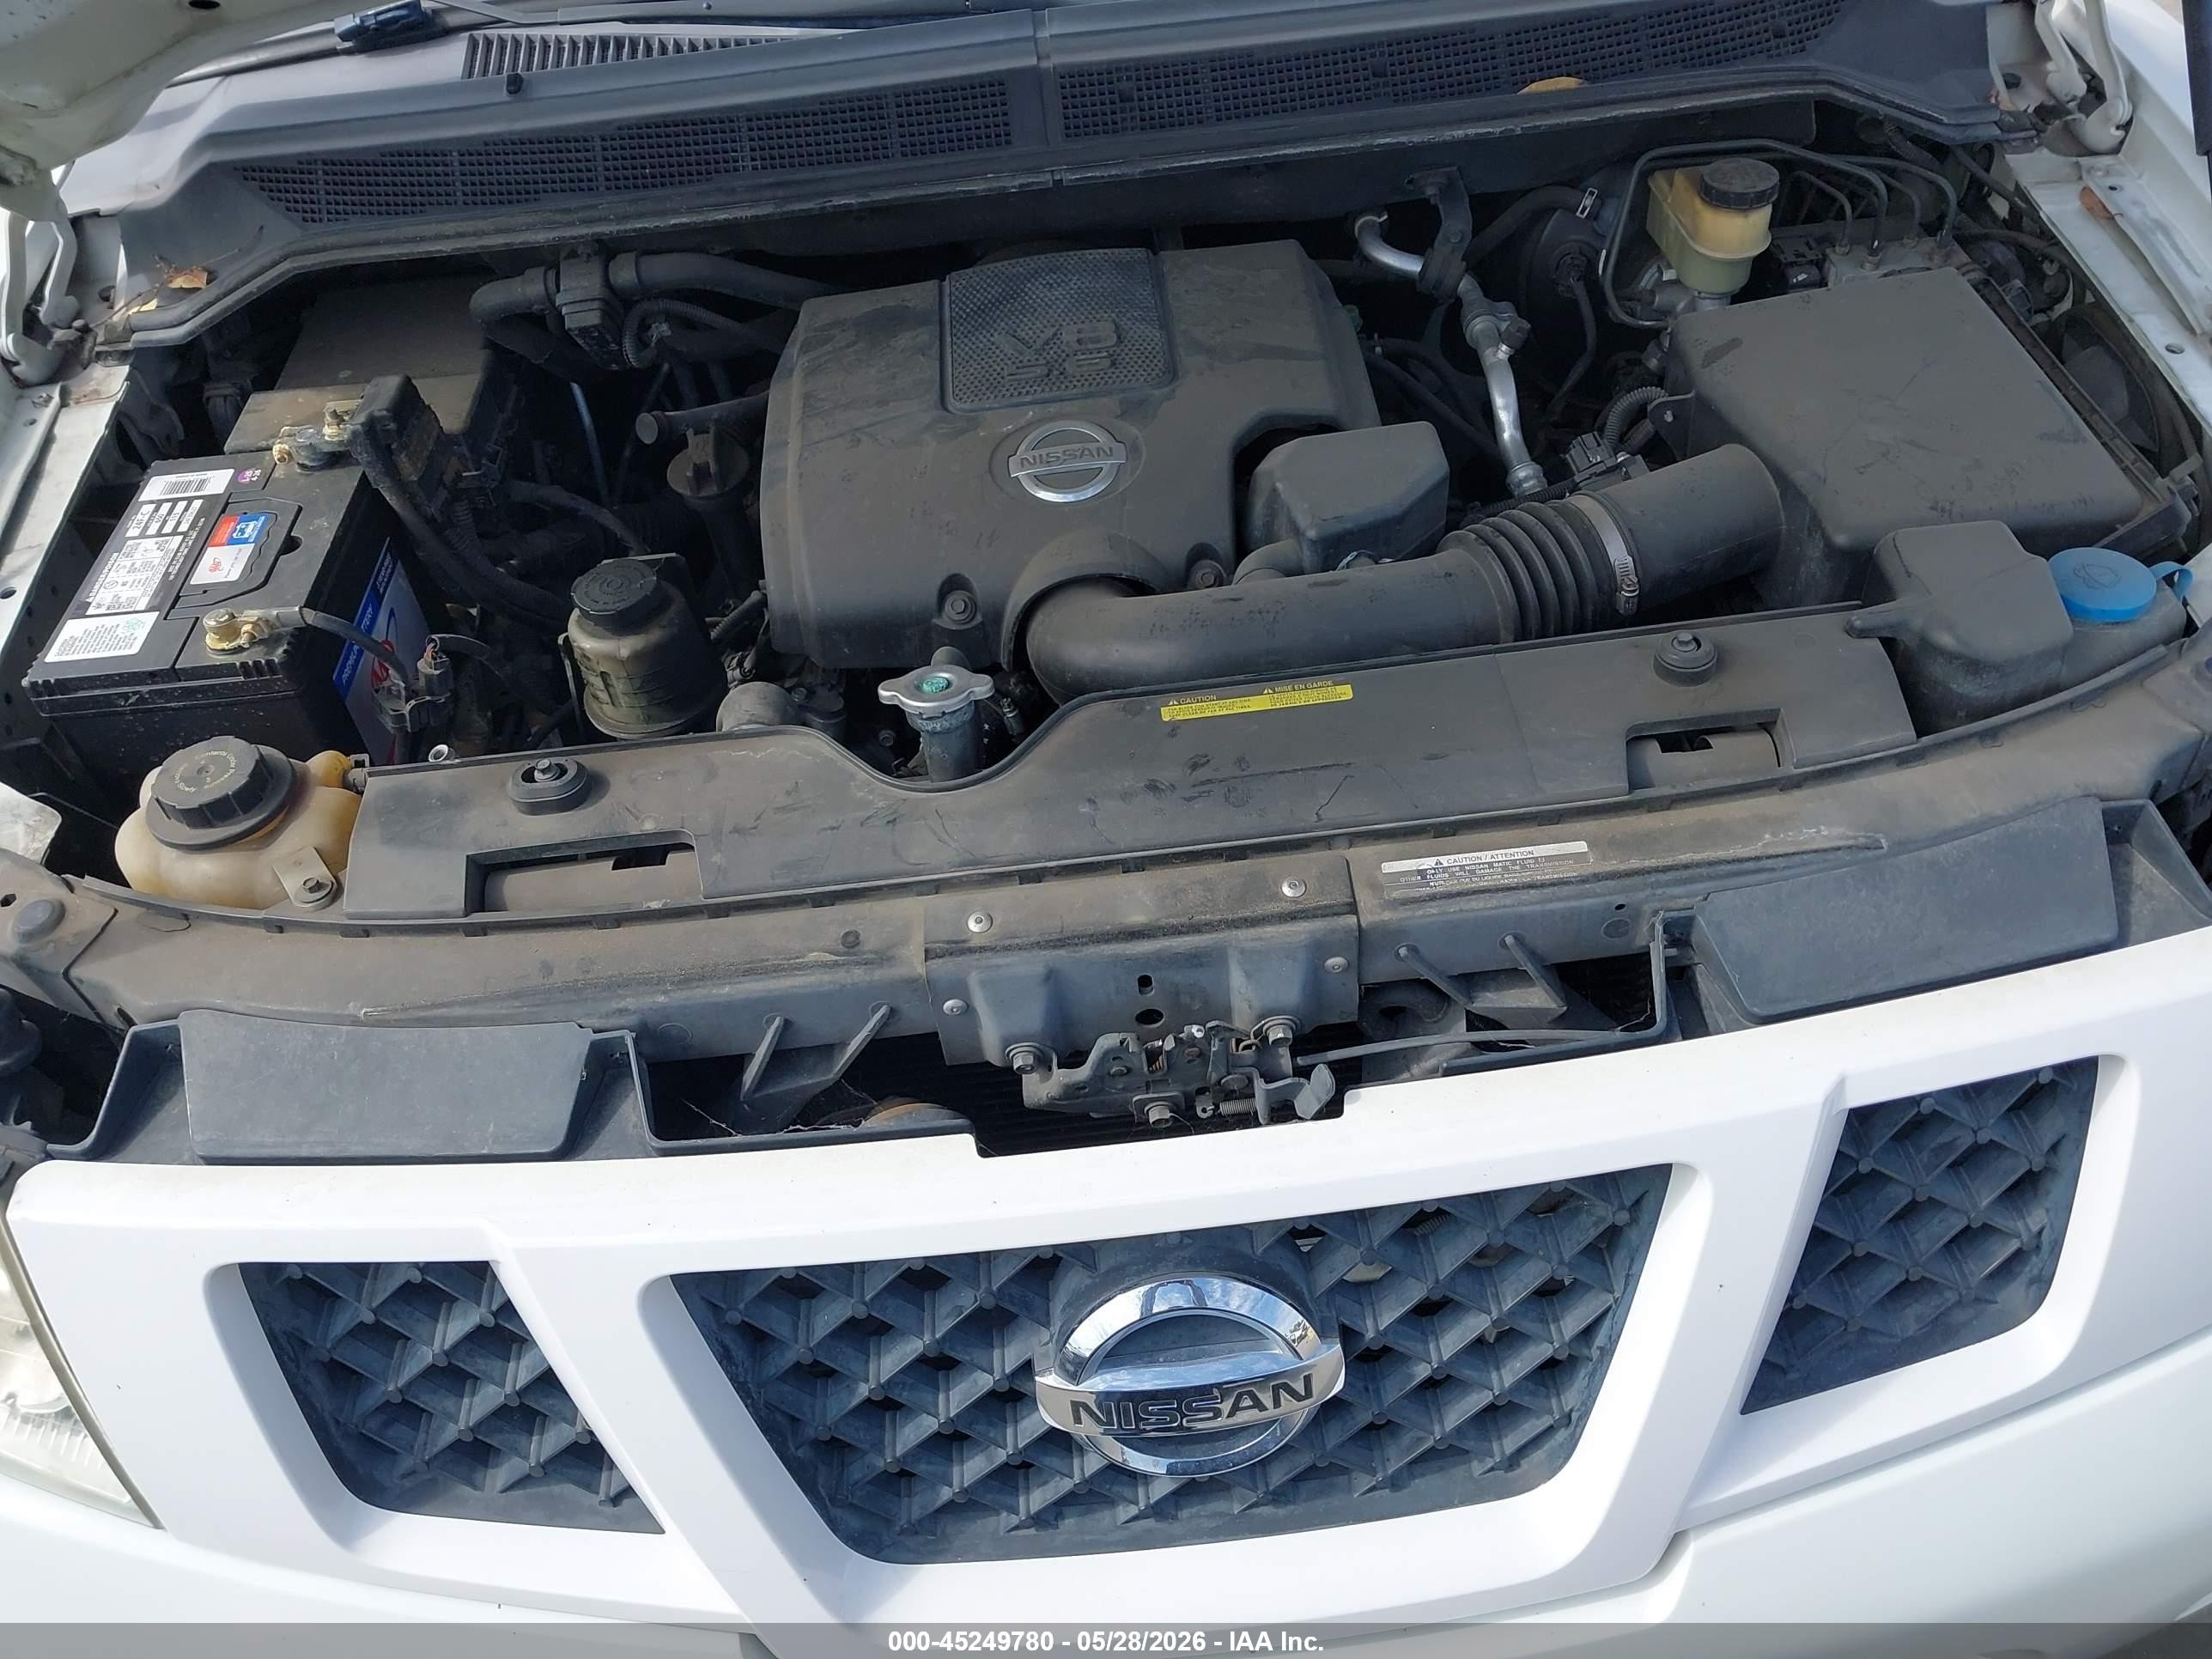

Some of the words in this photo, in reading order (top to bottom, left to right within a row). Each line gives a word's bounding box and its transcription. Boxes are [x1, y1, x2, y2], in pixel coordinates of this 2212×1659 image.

[1019, 445, 1114, 469] NISSAN
[1180, 694, 1216, 704] CAUTION
[1446, 855, 1483, 865] CAUTION
[1490, 850, 1534, 860] ATTENTION
[1525, 859, 1573, 868] TRANSMISSION
[1069, 1373, 1314, 1430] NISSAN
